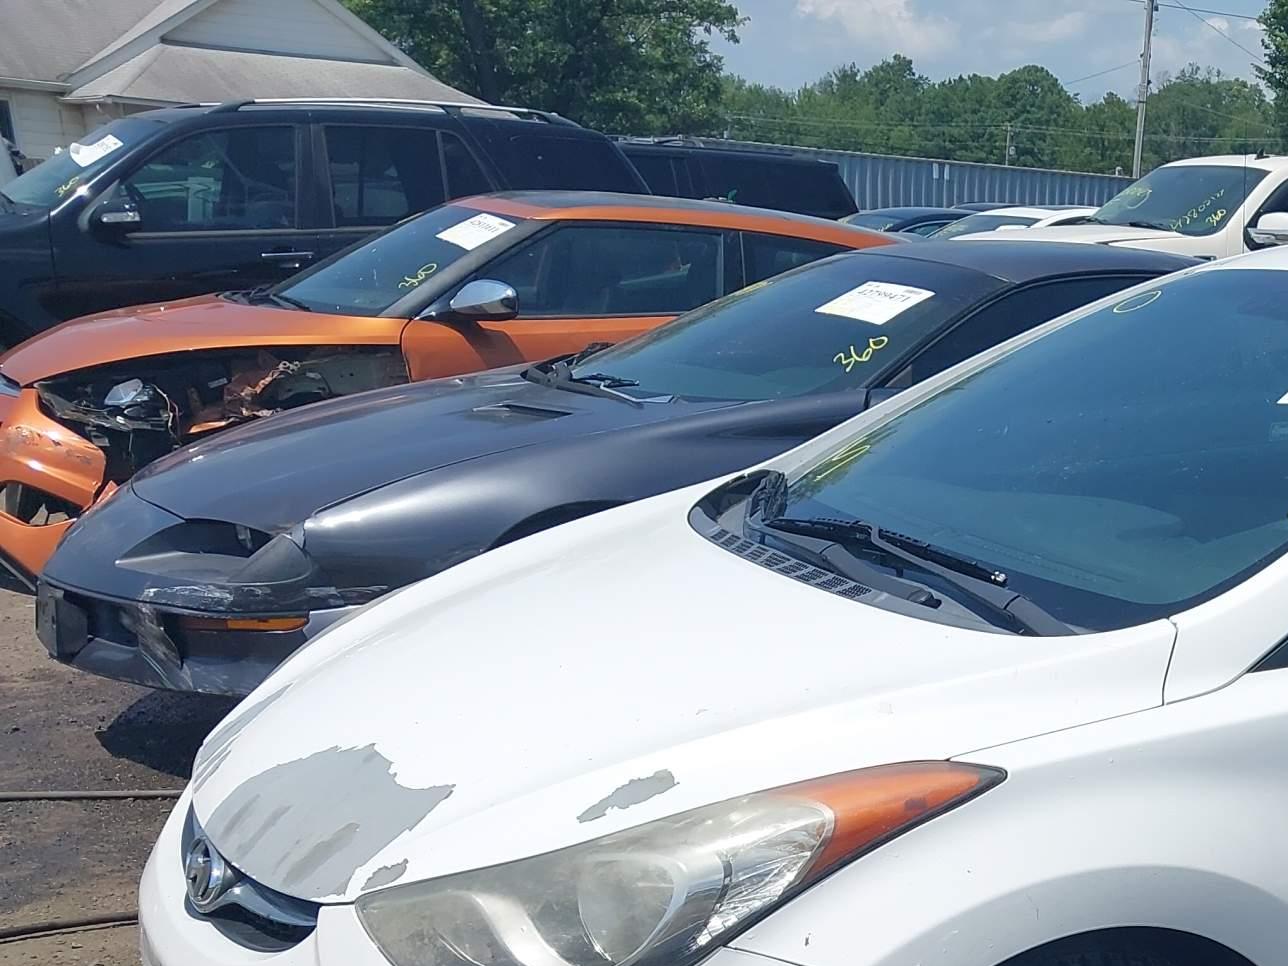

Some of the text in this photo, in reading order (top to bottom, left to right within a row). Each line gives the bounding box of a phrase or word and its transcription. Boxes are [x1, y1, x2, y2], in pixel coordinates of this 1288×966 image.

[1205, 208, 1227, 227] 360
[398, 262, 438, 289] 360
[832, 335, 889, 373] 360
